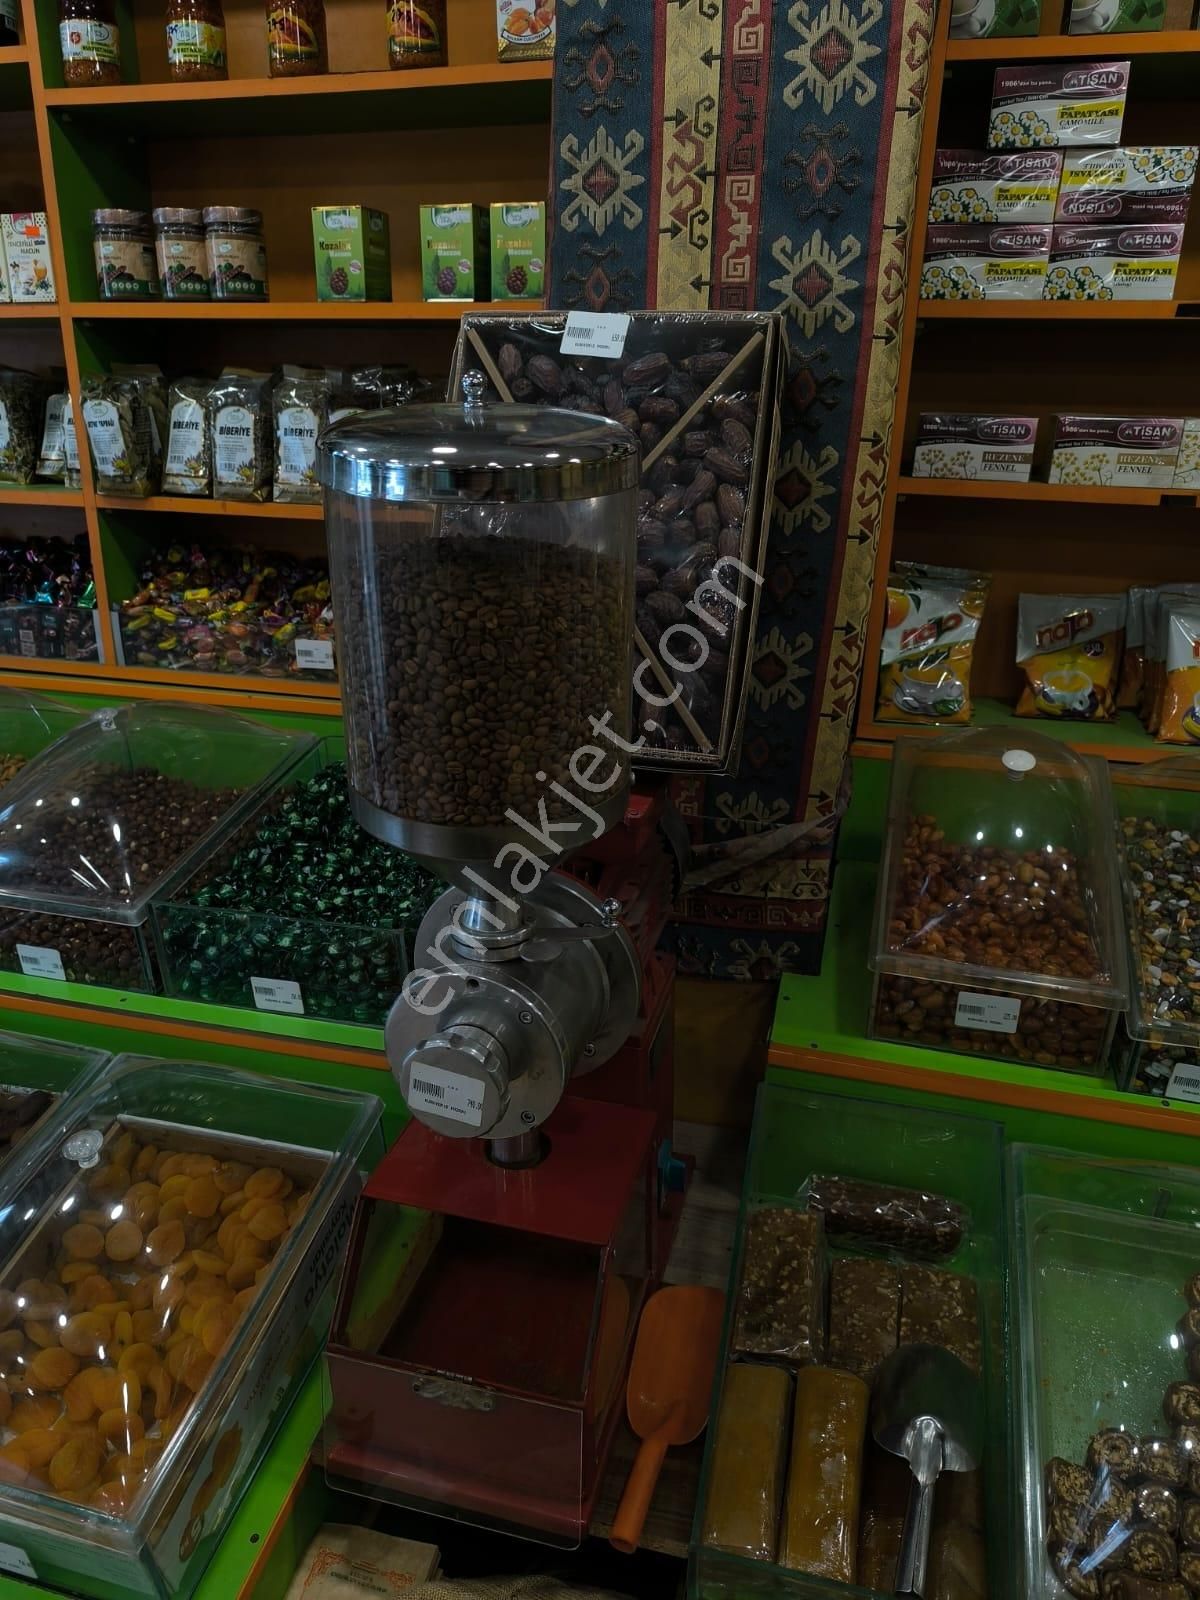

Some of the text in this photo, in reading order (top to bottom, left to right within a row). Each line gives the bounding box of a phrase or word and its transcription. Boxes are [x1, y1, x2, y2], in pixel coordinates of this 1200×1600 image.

[219, 424, 251, 437] BİBERİYE
[983, 463, 1017, 473] FENNEL
[1118, 464, 1153, 474] FENNEL
